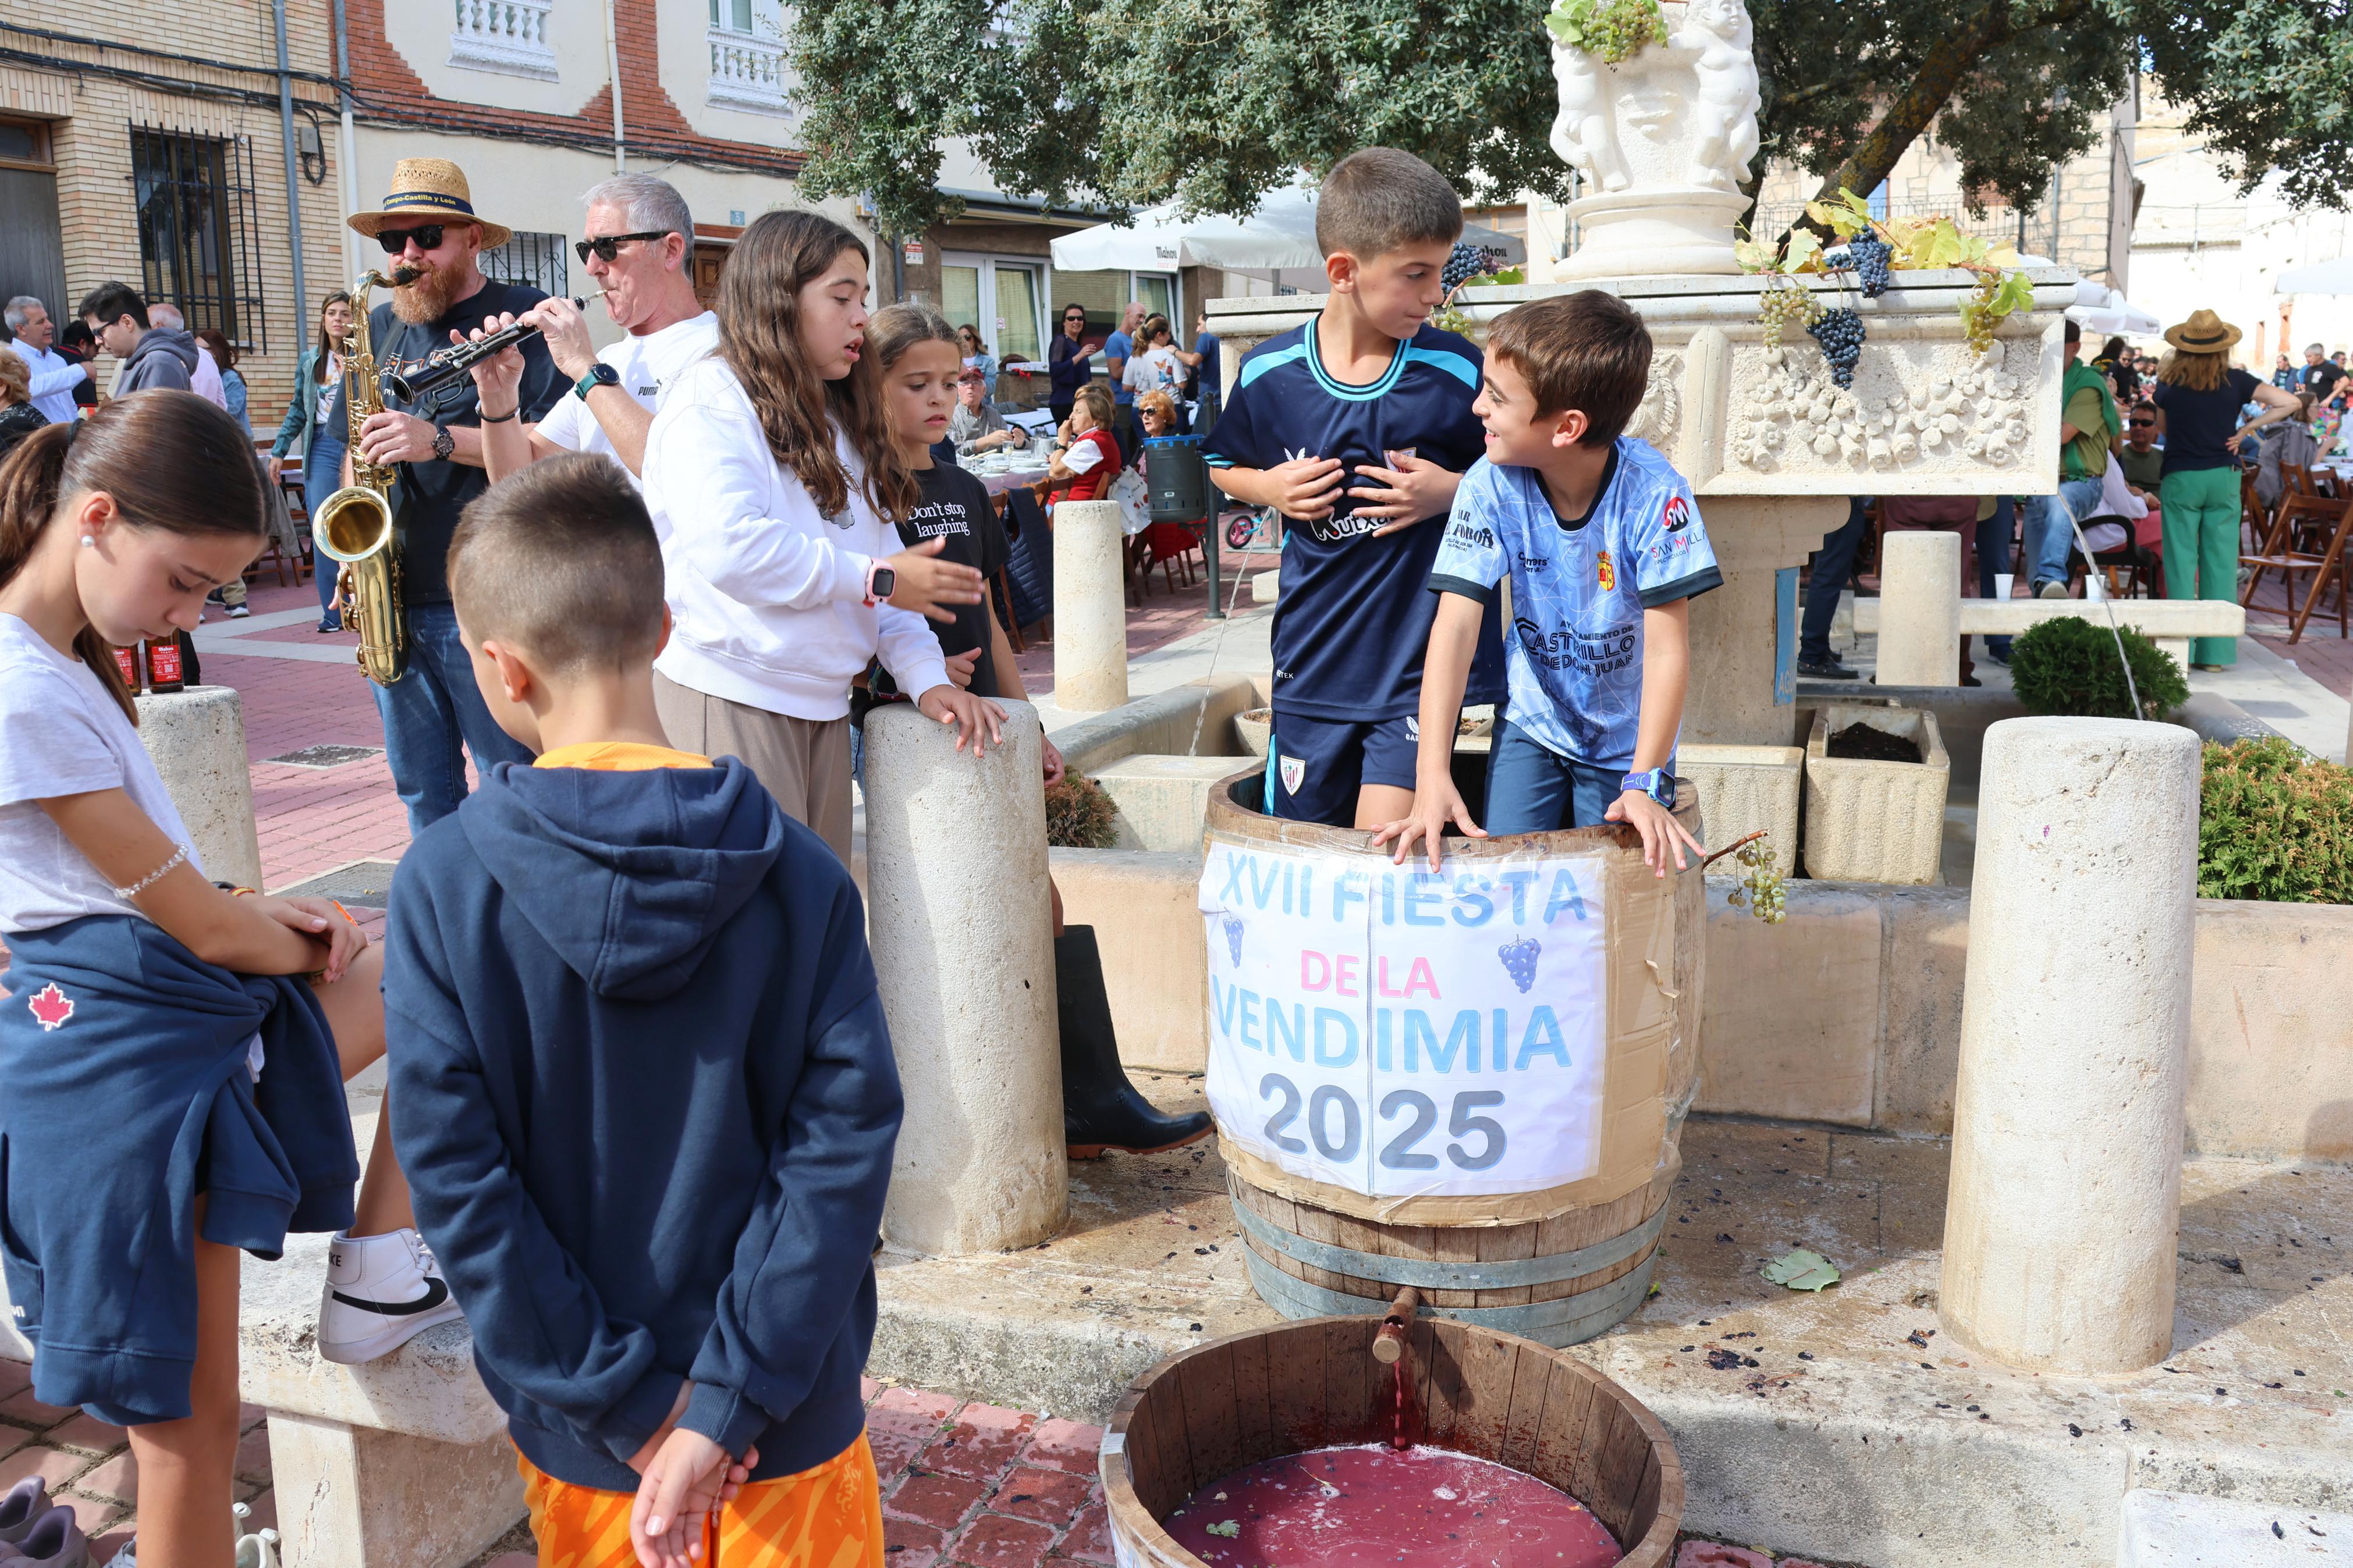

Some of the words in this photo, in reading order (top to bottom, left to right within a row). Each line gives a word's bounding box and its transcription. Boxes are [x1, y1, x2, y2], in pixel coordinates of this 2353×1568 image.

[735, 212, 740, 223] 5
[1156, 246, 1177, 259] Mahou
[638, 386, 659, 396] PUMA
[944, 502, 966, 518] stop
[914, 518, 970, 538] laughing
[1651, 541, 1672, 558] SAN
[1515, 617, 1635, 661] CASTRILLO
[1621, 625, 1634, 634] DE
[1540, 653, 1560, 670] DE
[1562, 655, 1591, 675] DON
[1220, 851, 1312, 918] XVII
[1332, 867, 1588, 927] FIESTA
[1300, 949, 1360, 997] DE
[1378, 955, 1442, 1000] LA
[1212, 975, 1573, 1074] VENDIMIA
[1259, 1072, 1507, 1172] 2025
